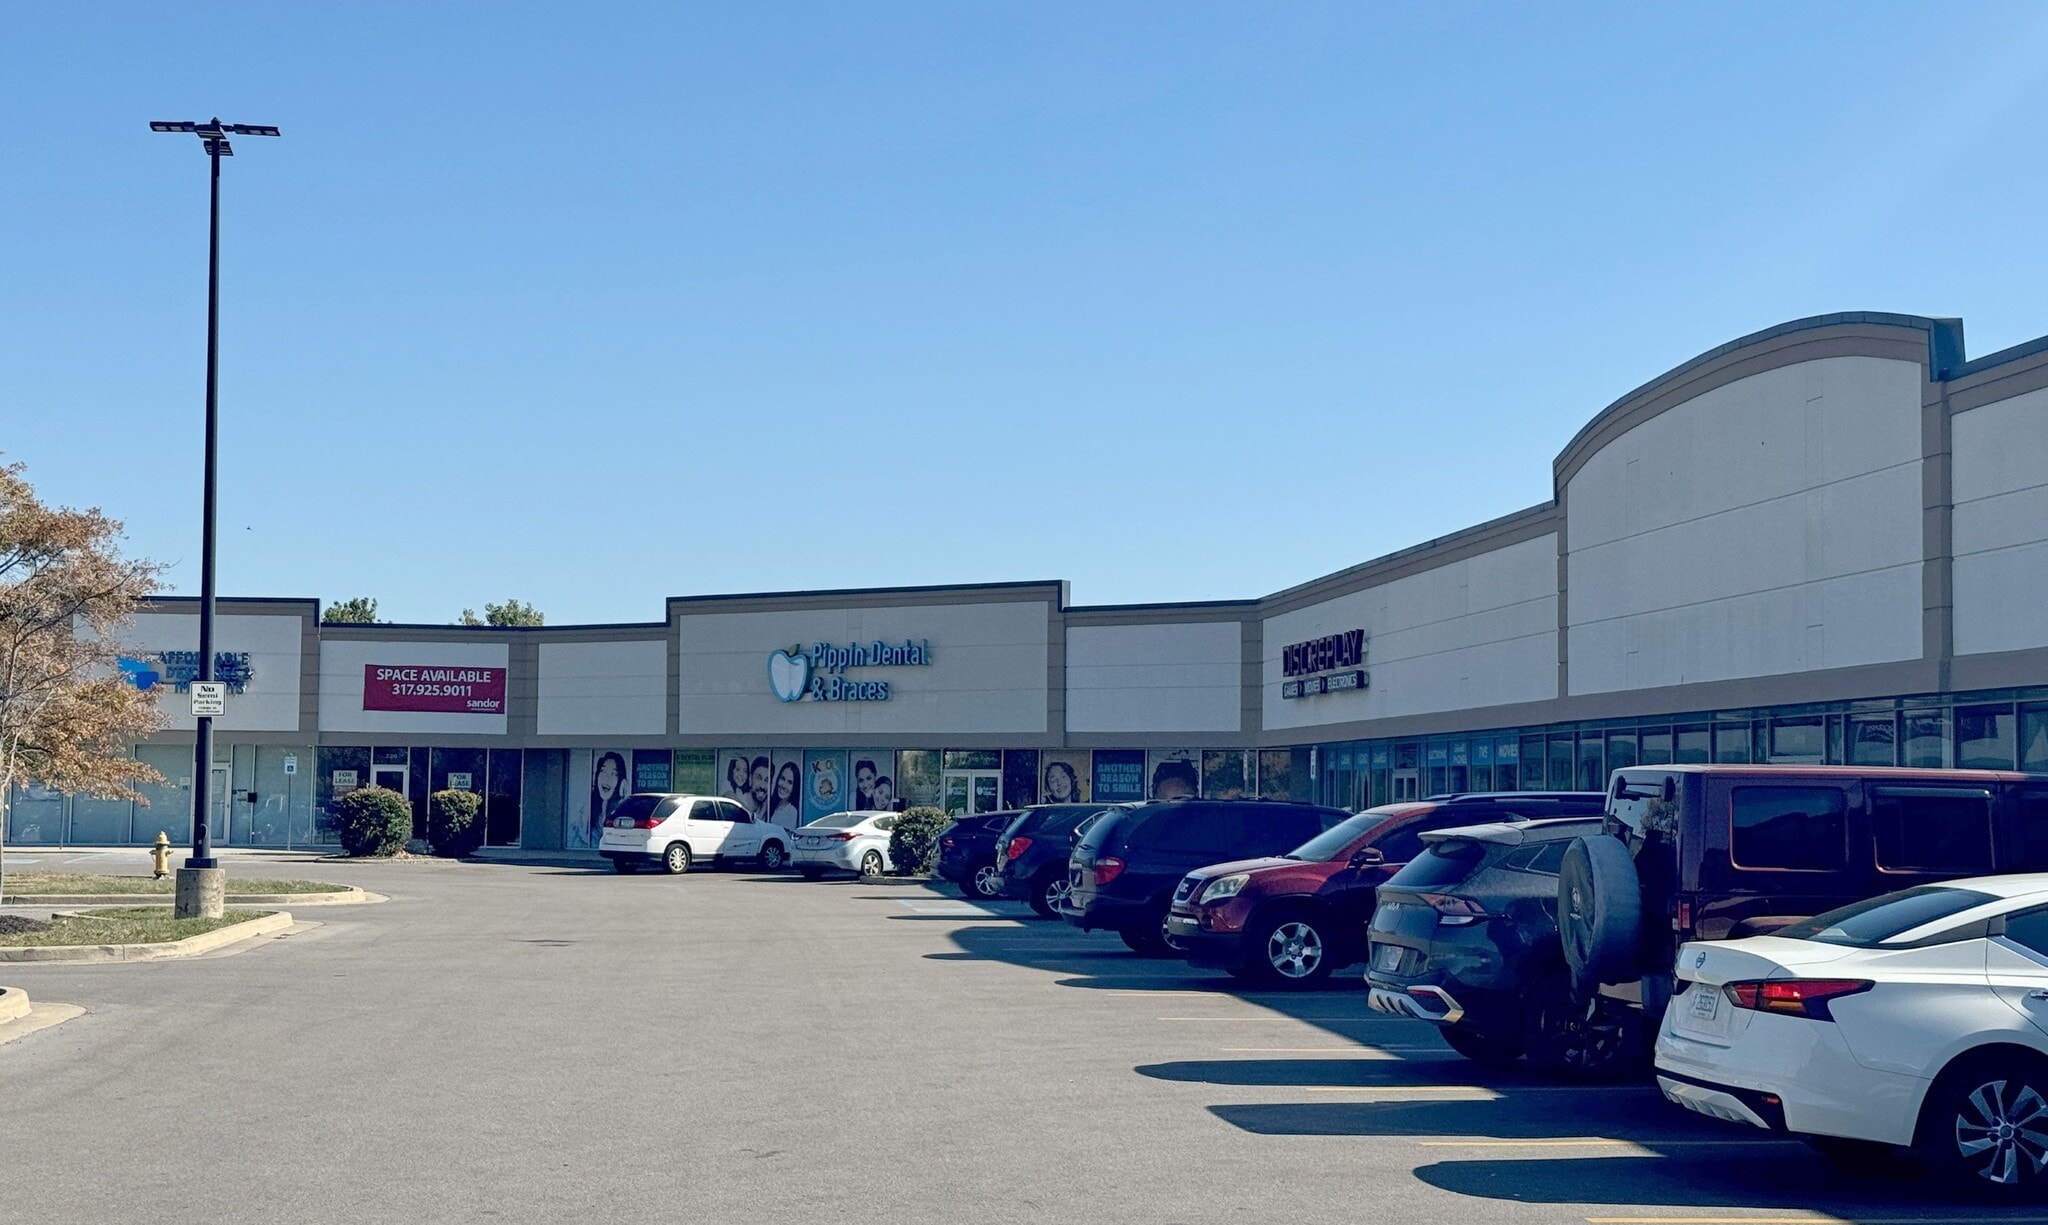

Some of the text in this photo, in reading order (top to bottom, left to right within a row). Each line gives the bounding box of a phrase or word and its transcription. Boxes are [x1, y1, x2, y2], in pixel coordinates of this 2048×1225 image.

[811, 639, 928, 674] Pippin Dental
[1282, 629, 1364, 677] DISCREPLAY
[376, 668, 491, 683] SPACE AVAILABLE
[392, 683, 472, 697] 317.925.9011
[811, 676, 889, 701] & Braces
[466, 698, 501, 708] sandor
[636, 763, 670, 772] ANOTHER
[1097, 763, 1142, 773] ANOTHER
[638, 772, 668, 780] REASON
[1100, 773, 1139, 783] REASON
[637, 780, 669, 789] TO SMILE
[1097, 783, 1142, 793] TO SMILE
